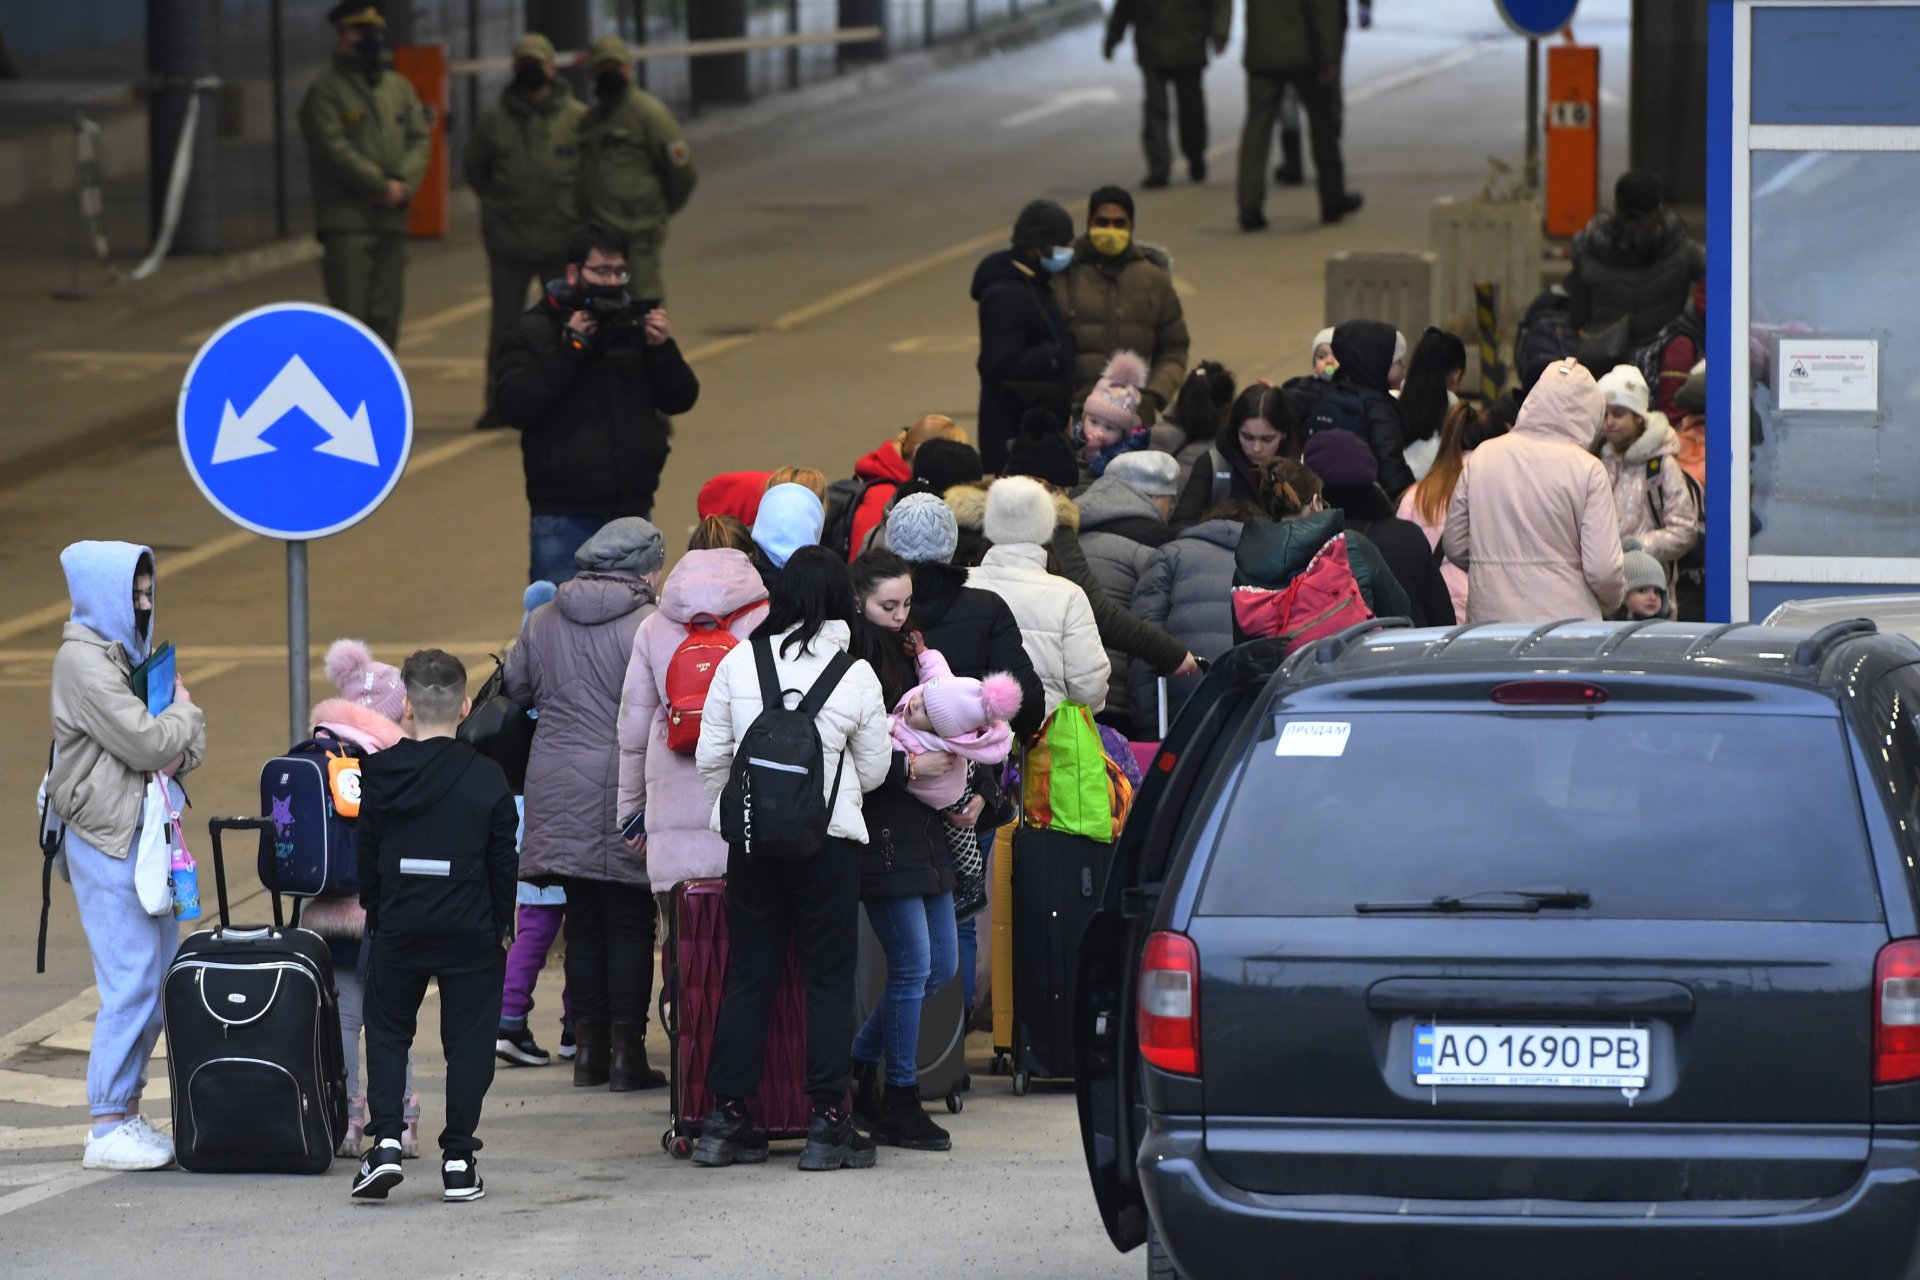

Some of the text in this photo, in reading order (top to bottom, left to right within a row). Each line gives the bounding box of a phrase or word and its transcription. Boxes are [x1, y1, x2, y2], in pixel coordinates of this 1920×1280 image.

[1286, 725, 1347, 736] ПРОДАМ
[1498, 1034, 1580, 1068] 1690
[1417, 1056, 1432, 1068] UA
